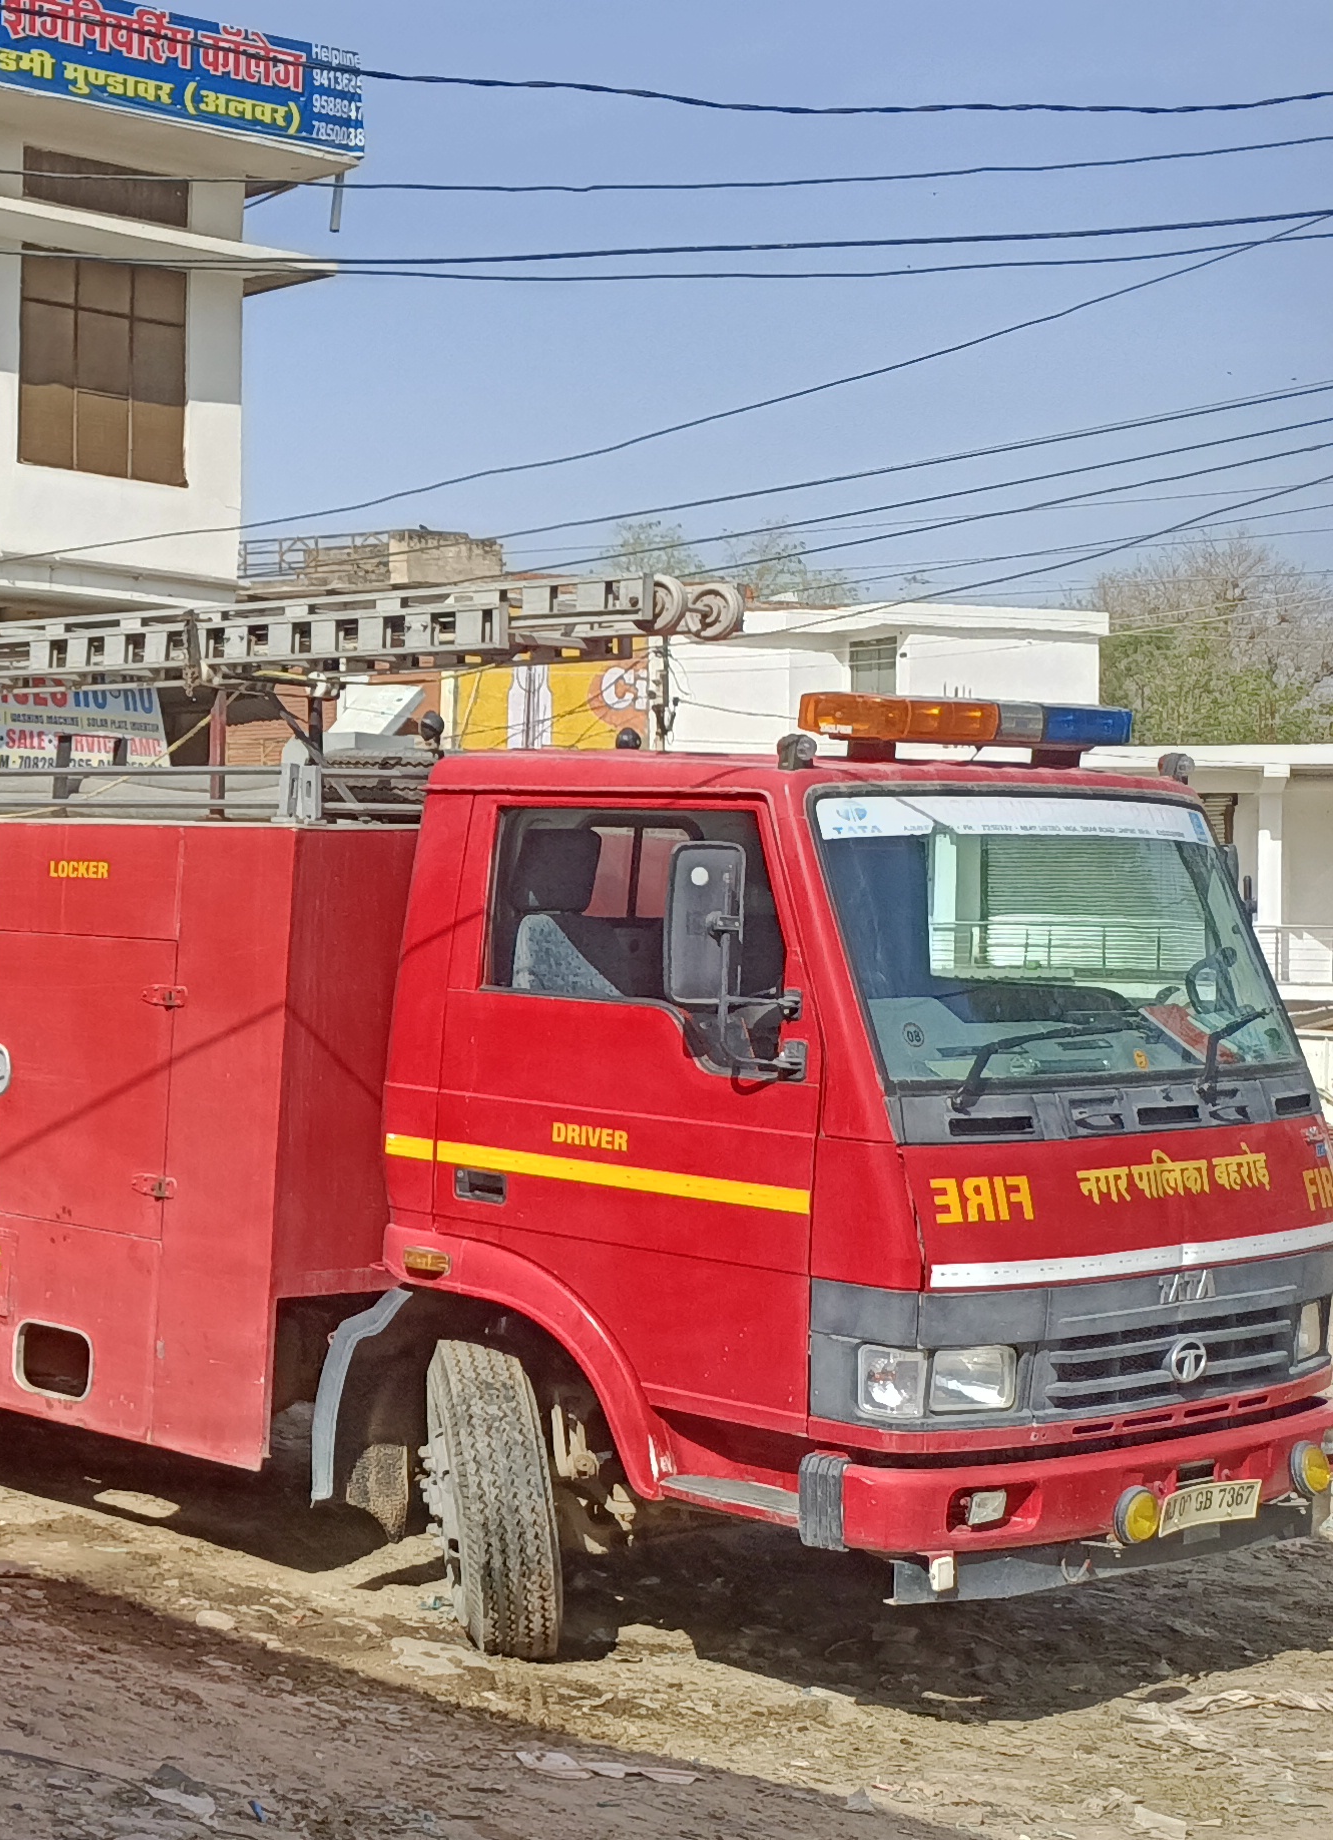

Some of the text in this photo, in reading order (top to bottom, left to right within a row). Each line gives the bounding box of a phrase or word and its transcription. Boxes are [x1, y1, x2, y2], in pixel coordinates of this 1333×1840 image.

[199, 25, 306, 93] कॉलेज
[312, 43, 361, 68] Helpline
[5, 728, 46, 750] SALE
[833, 825, 882, 834] TATA
[49, 860, 109, 879] LOCKER
[552, 1121, 628, 1152] DRIVER
[1076, 1166, 1132, 1205] नगर
[1131, 1149, 1211, 1199] पालिका
[1158, 1268, 1216, 1305] TATA
[1195, 1489, 1213, 1512] GB
[1218, 1484, 1255, 1509] 7367
